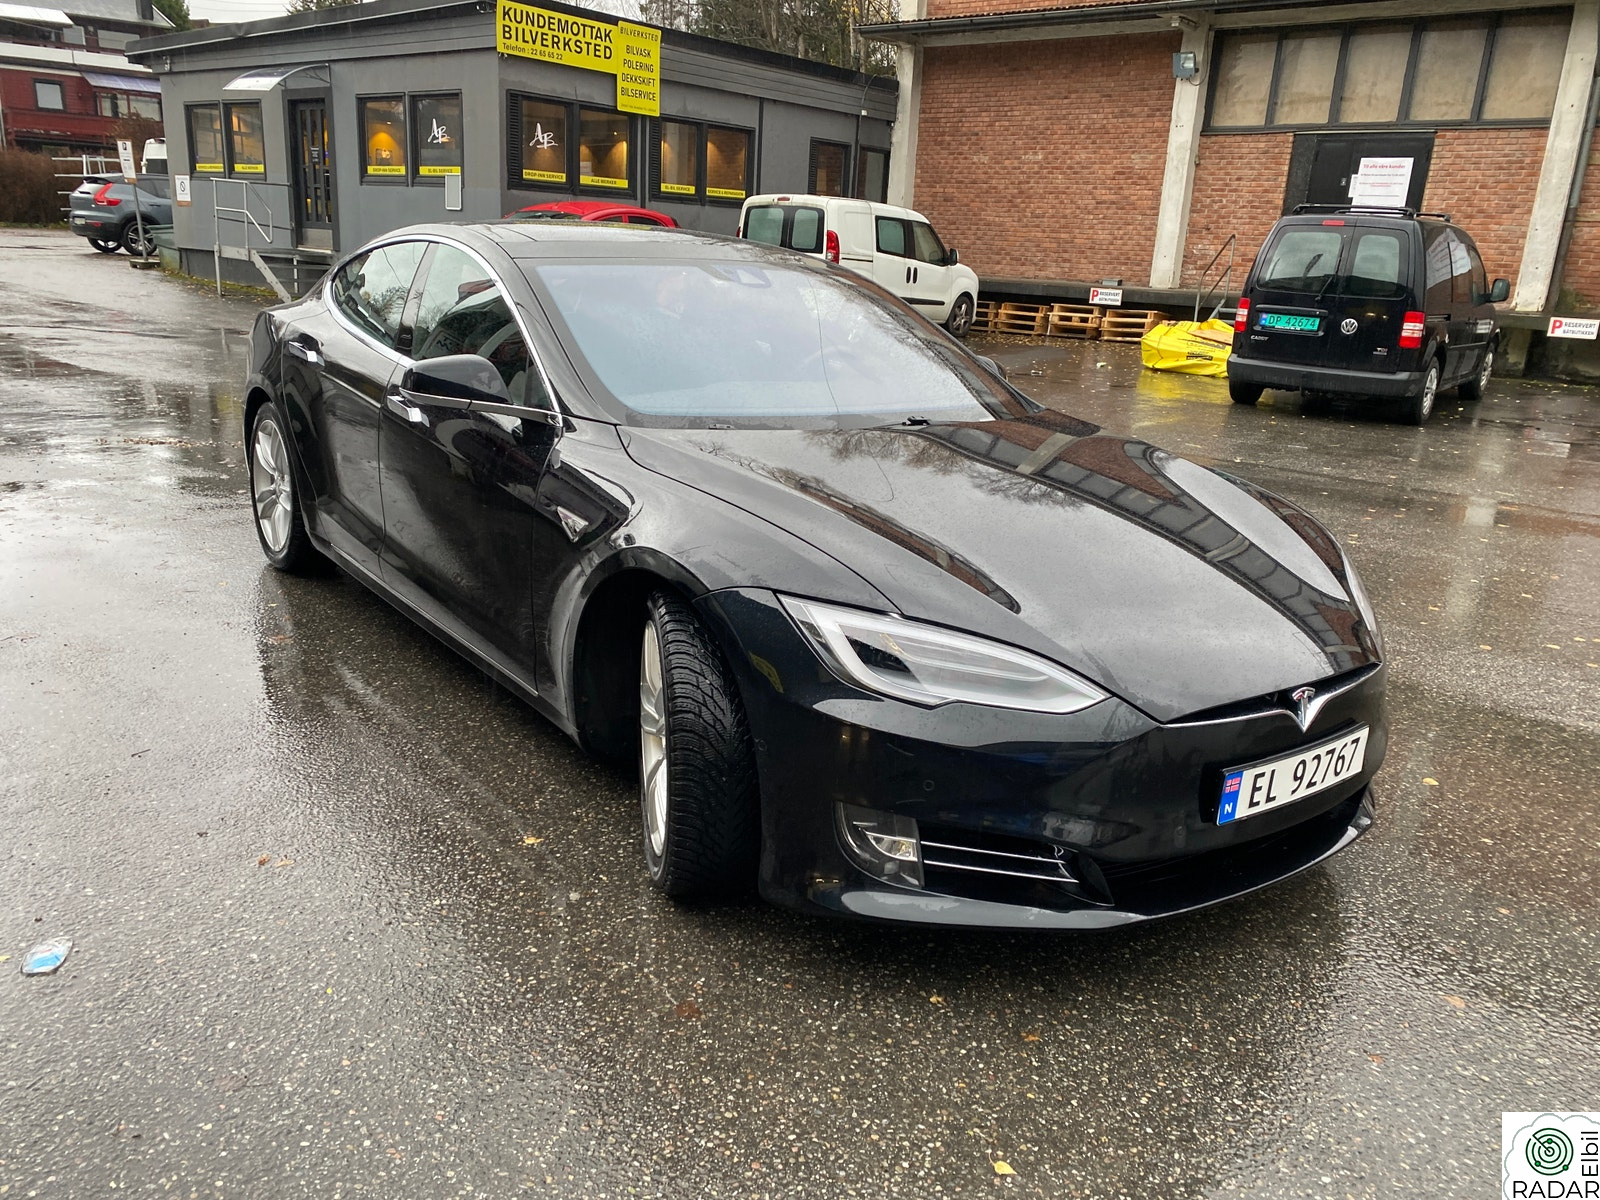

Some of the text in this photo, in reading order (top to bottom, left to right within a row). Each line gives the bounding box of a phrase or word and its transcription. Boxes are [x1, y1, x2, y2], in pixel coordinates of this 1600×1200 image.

[502, 6, 613, 44] KUNDEMOTTAK
[502, 24, 613, 60] BILVERKSTED
[620, 26, 659, 42] BILVERKSTED
[502, 43, 526, 53] Telefon
[530, 48, 538, 56] 22
[539, 49, 547, 57] 65
[547, 51, 555, 59] 65
[555, 52, 563, 61] 22
[626, 44, 652, 59] BILVASK
[623, 58, 654, 74] POLERING
[621, 73, 656, 88] DEKKSKIFT
[620, 87, 656, 102] BILSERVICE
[1091, 289, 1099, 302] P
[1268, 315, 1282, 325] DP
[1285, 316, 1316, 329] 42674
[1551, 319, 1596, 335] P RESERVERT
[1248, 736, 1361, 809] EL 92767
[1223, 802, 1233, 815] N
